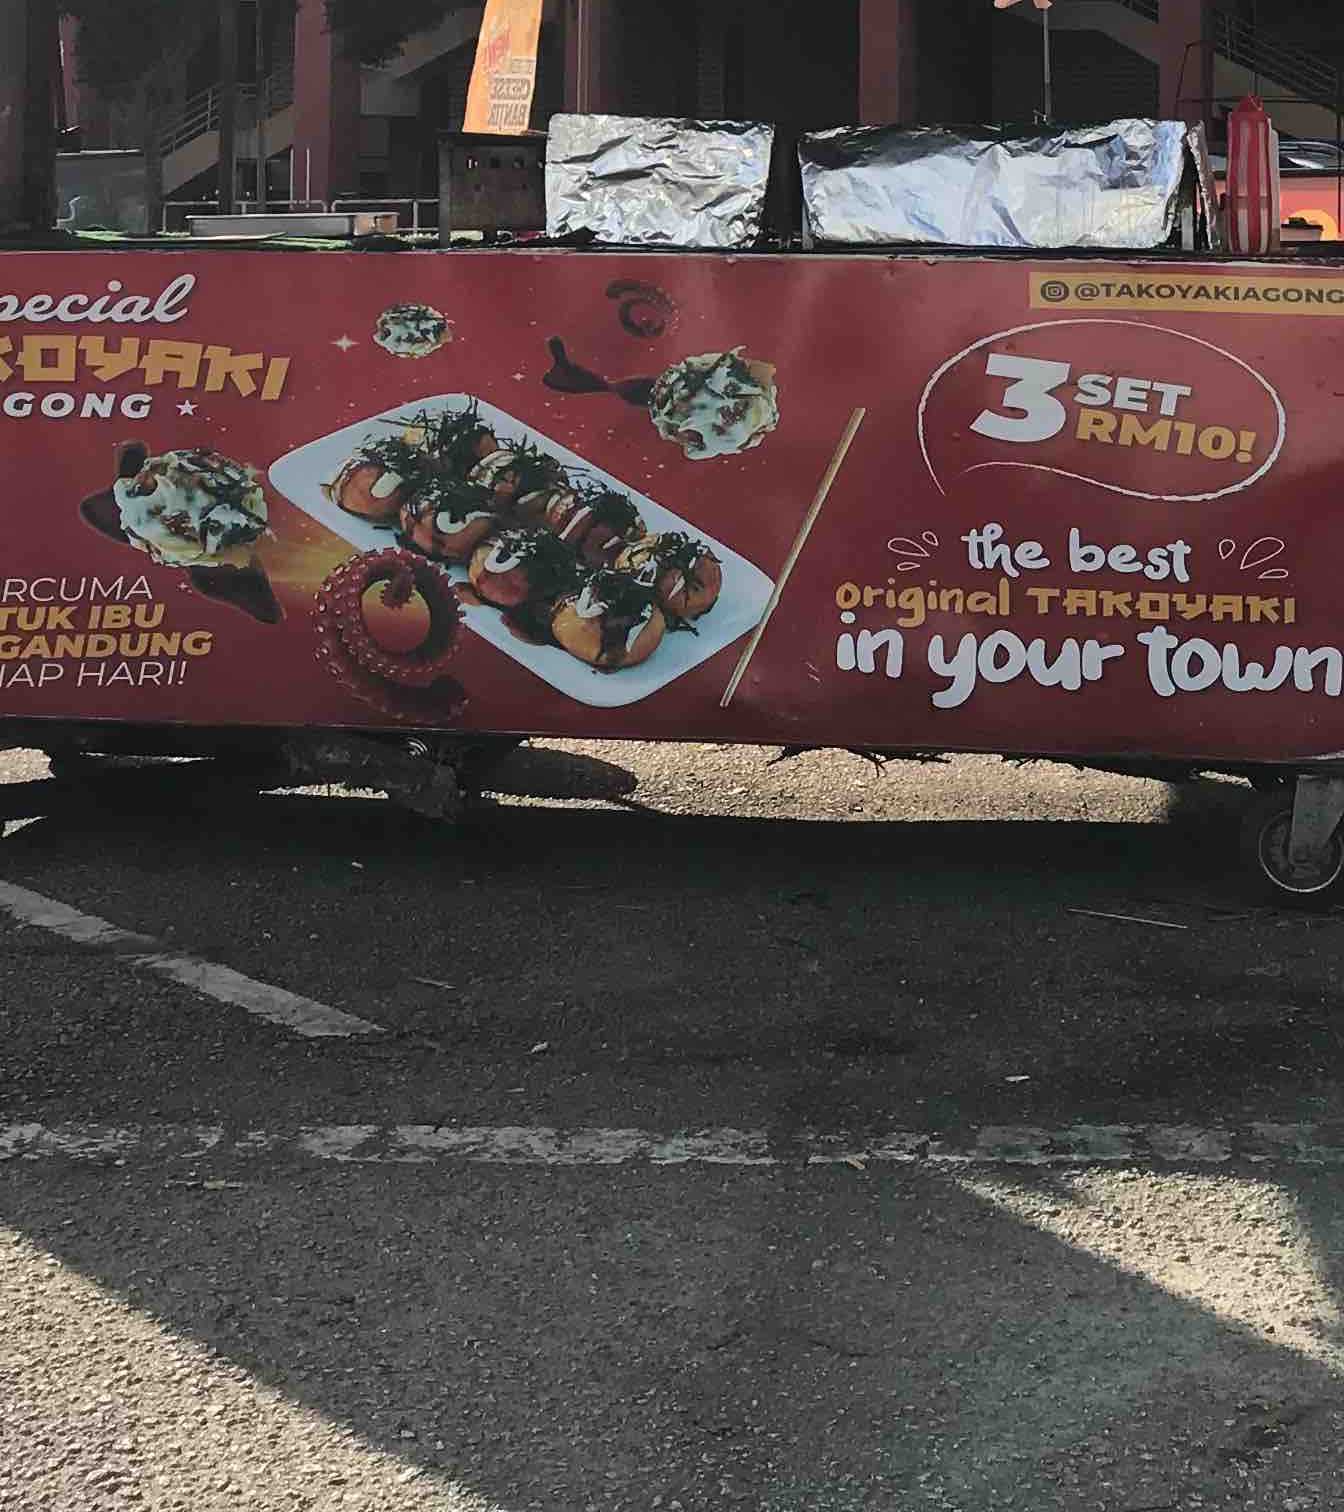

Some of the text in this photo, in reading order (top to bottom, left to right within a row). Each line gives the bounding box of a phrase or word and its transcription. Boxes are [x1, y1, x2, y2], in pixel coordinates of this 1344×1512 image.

[968, 352, 1192, 443] 3 SET
[1074, 407, 1257, 465] RM10!
[961, 522, 1192, 583] the best
[87, 602, 166, 629] IBU
[835, 579, 1297, 627] original TAKOYAKI
[76, 659, 188, 688] HARI!
[835, 609, 1344, 709] in your town
